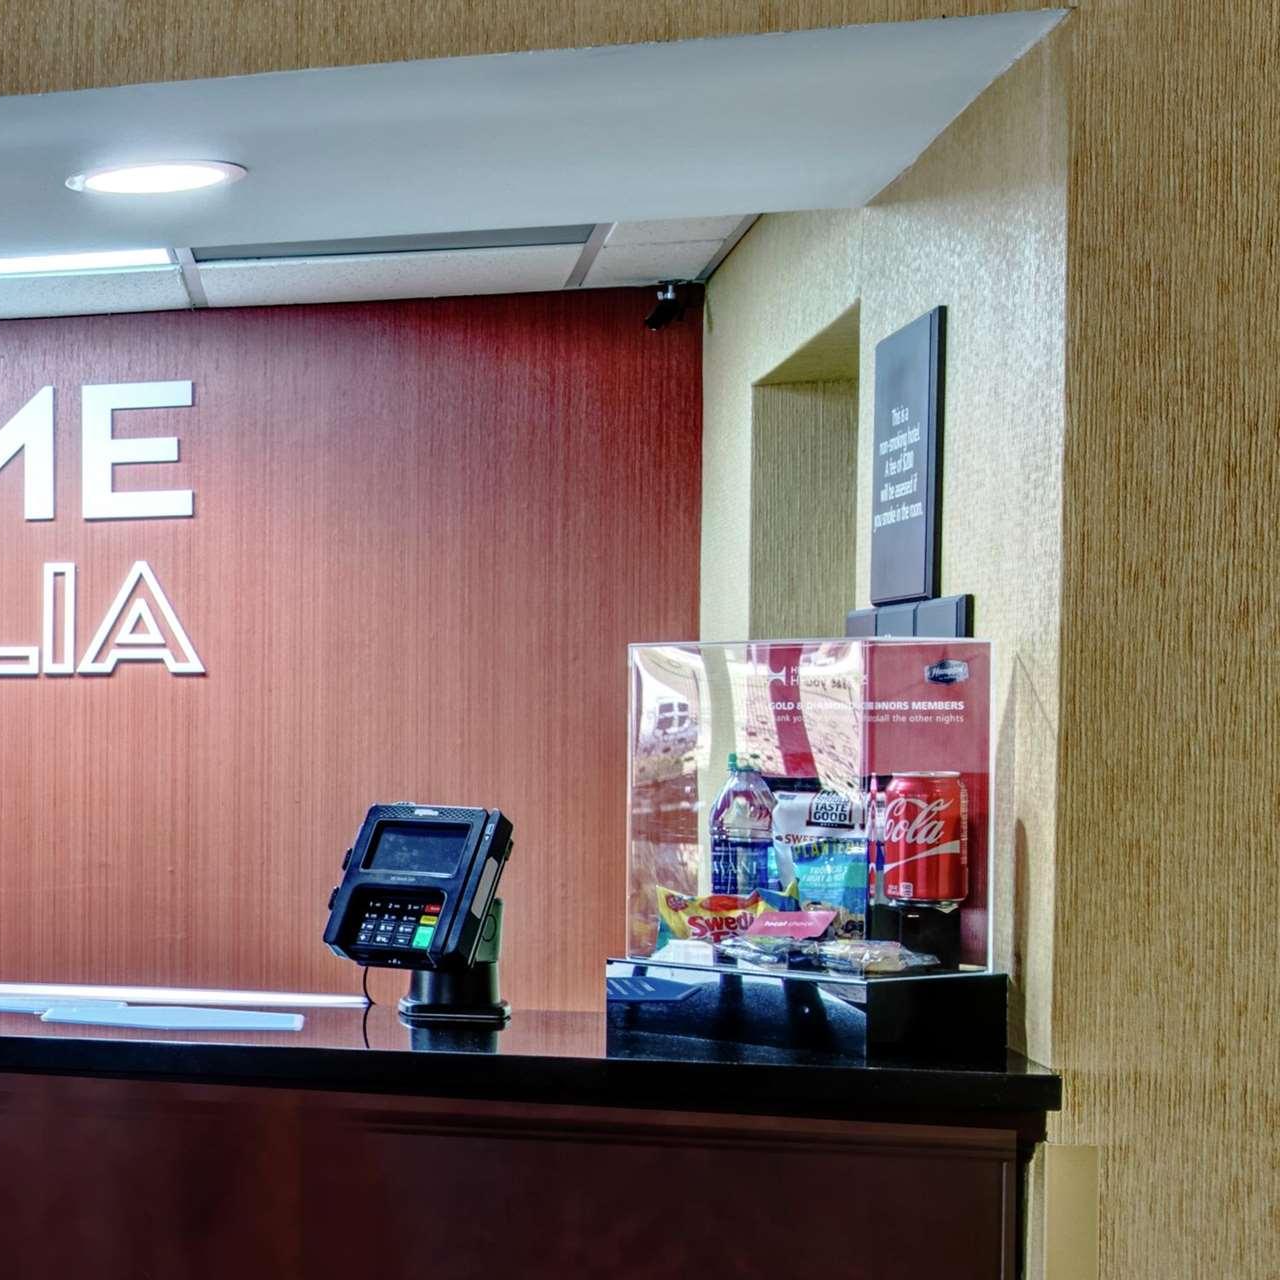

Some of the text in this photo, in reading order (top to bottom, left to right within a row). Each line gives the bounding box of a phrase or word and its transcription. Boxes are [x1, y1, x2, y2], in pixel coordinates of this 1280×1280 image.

[911, 701, 965, 711] MEMBERS
[892, 714, 907, 723] the
[908, 714, 933, 723] other
[935, 714, 965, 725] nights
[815, 802, 848, 812] TASTE
[813, 811, 848, 822] GOOD
